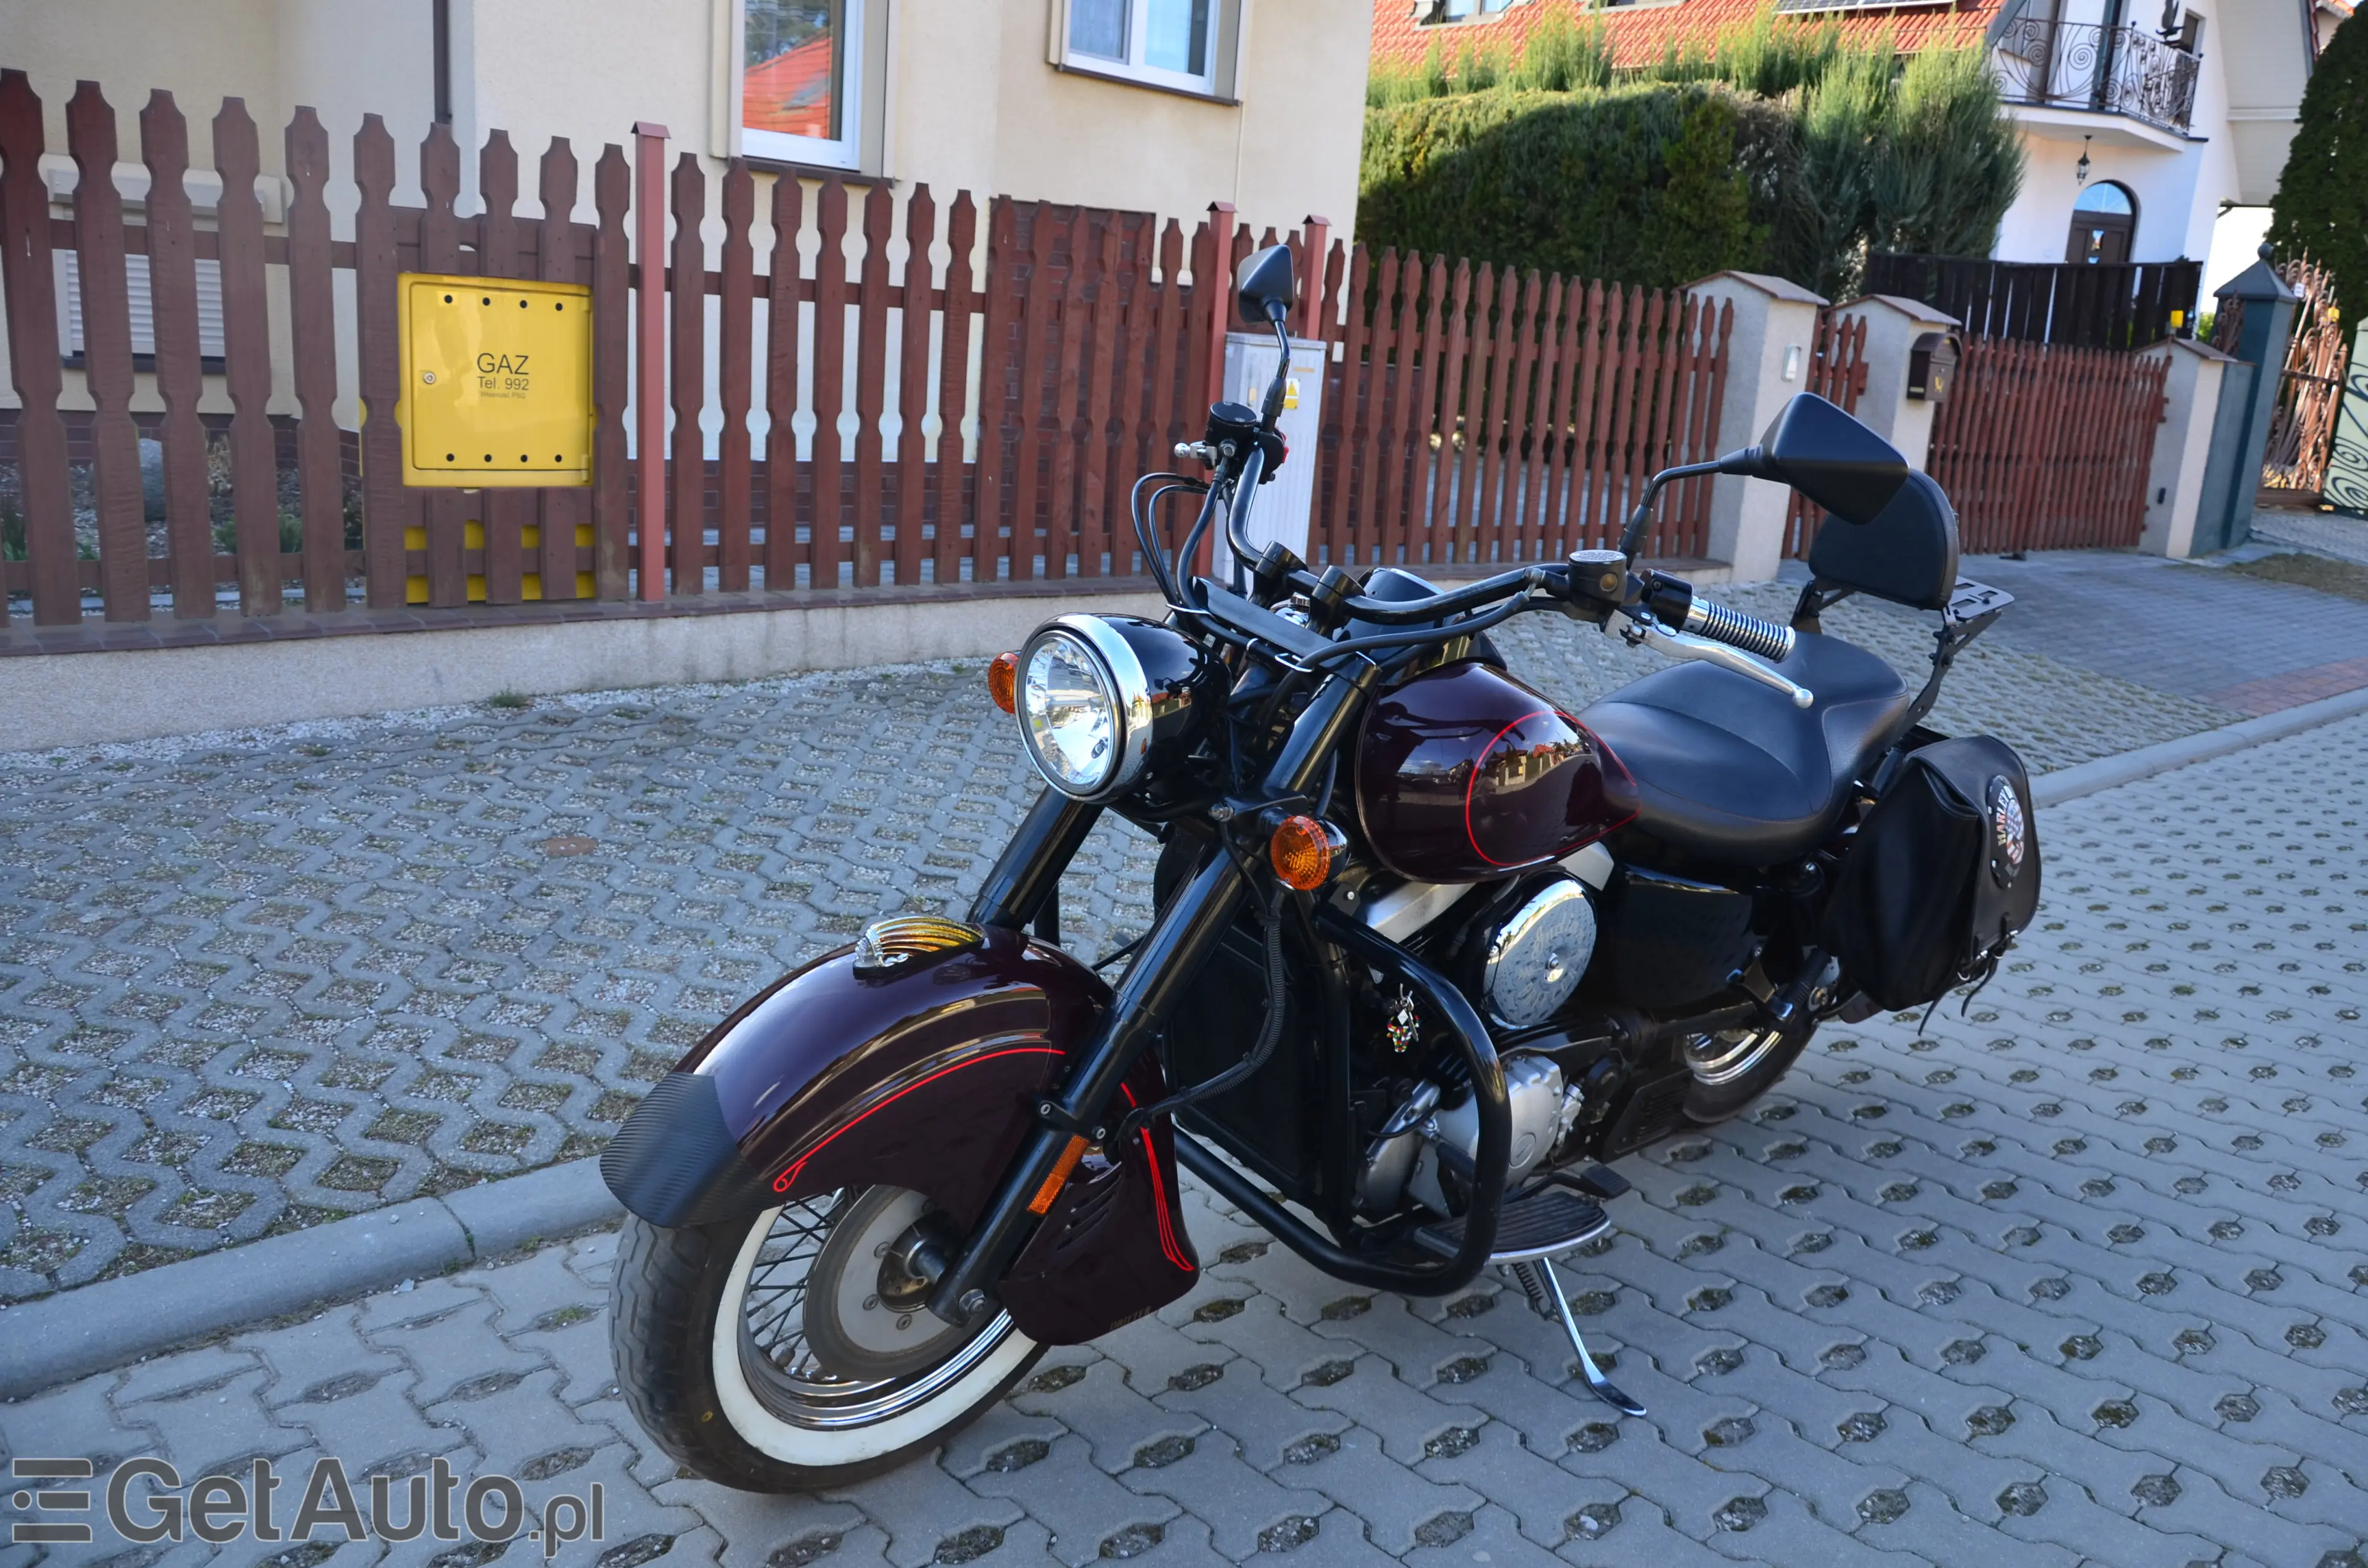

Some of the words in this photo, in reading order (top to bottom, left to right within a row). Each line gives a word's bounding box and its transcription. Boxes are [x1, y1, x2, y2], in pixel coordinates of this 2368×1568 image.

[477, 353, 529, 375] GAZ
[477, 376, 500, 389] Tel.
[504, 377, 530, 390] 992
